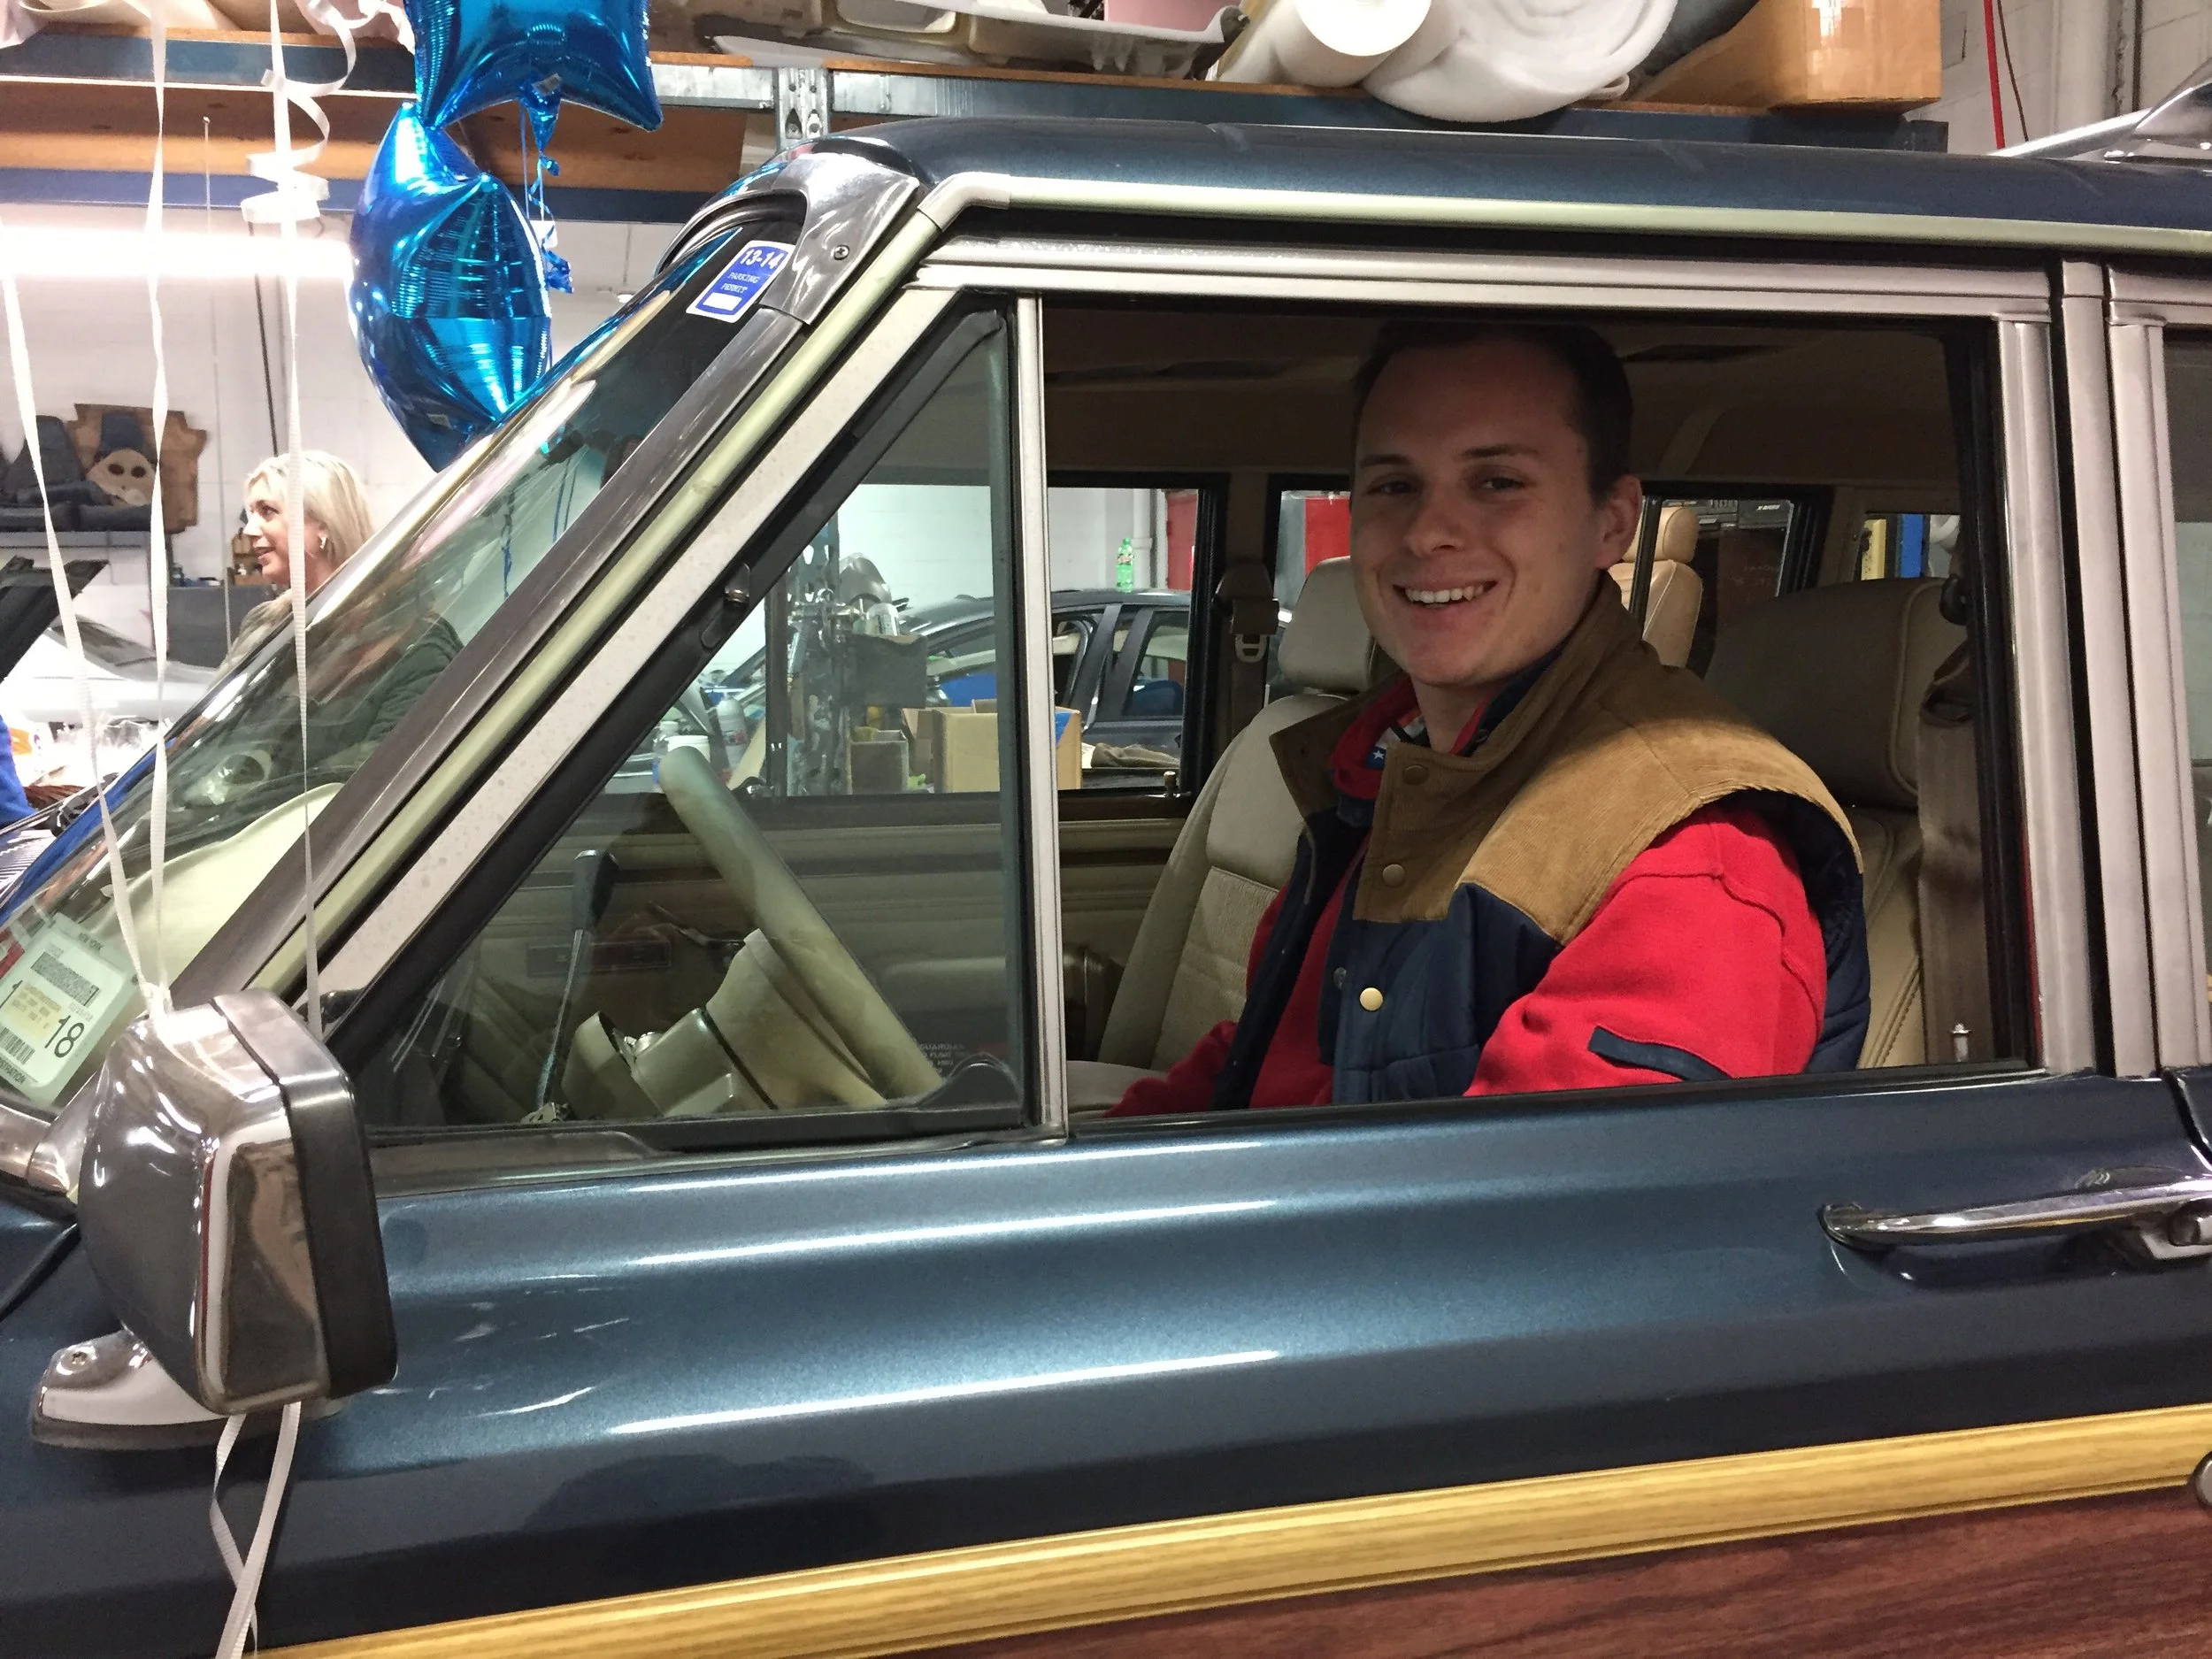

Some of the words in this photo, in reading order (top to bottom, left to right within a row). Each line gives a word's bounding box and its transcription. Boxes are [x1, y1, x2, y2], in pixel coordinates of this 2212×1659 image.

[741, 250, 784, 269] 13-14
[727, 272, 761, 283] PARKING
[720, 283, 748, 293] PERMIT
[44, 1014, 86, 1059] 18
